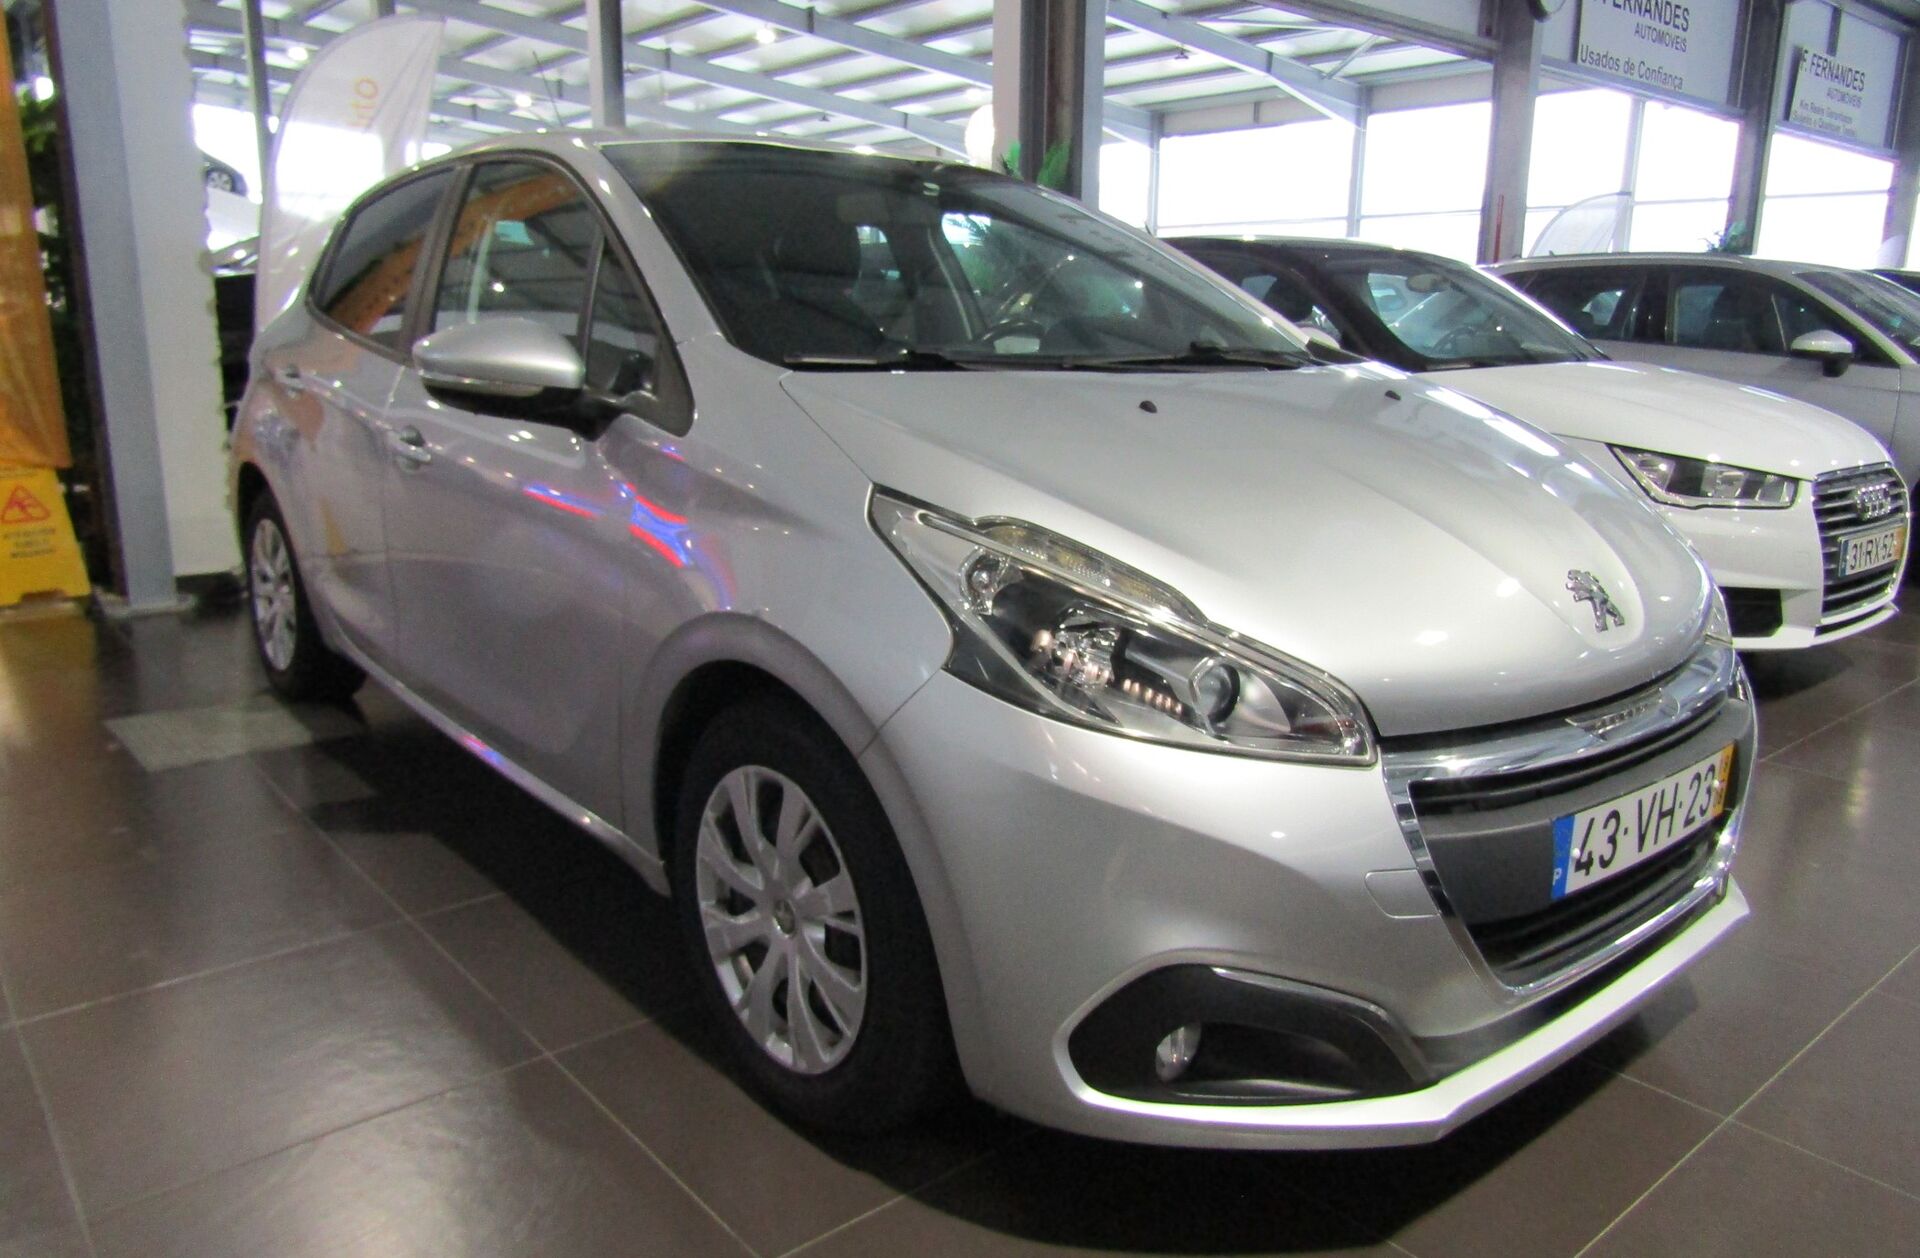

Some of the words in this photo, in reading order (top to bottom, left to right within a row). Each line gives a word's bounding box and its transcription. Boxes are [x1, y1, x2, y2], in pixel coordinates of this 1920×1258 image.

[1603, 0, 1690, 32] RNANDES
[1580, 44, 1620, 71] Usados
[1623, 57, 1636, 76] de
[1638, 61, 1684, 90] Confiança
[1810, 53, 1866, 92] FERNANDES
[1552, 868, 1562, 886] P
